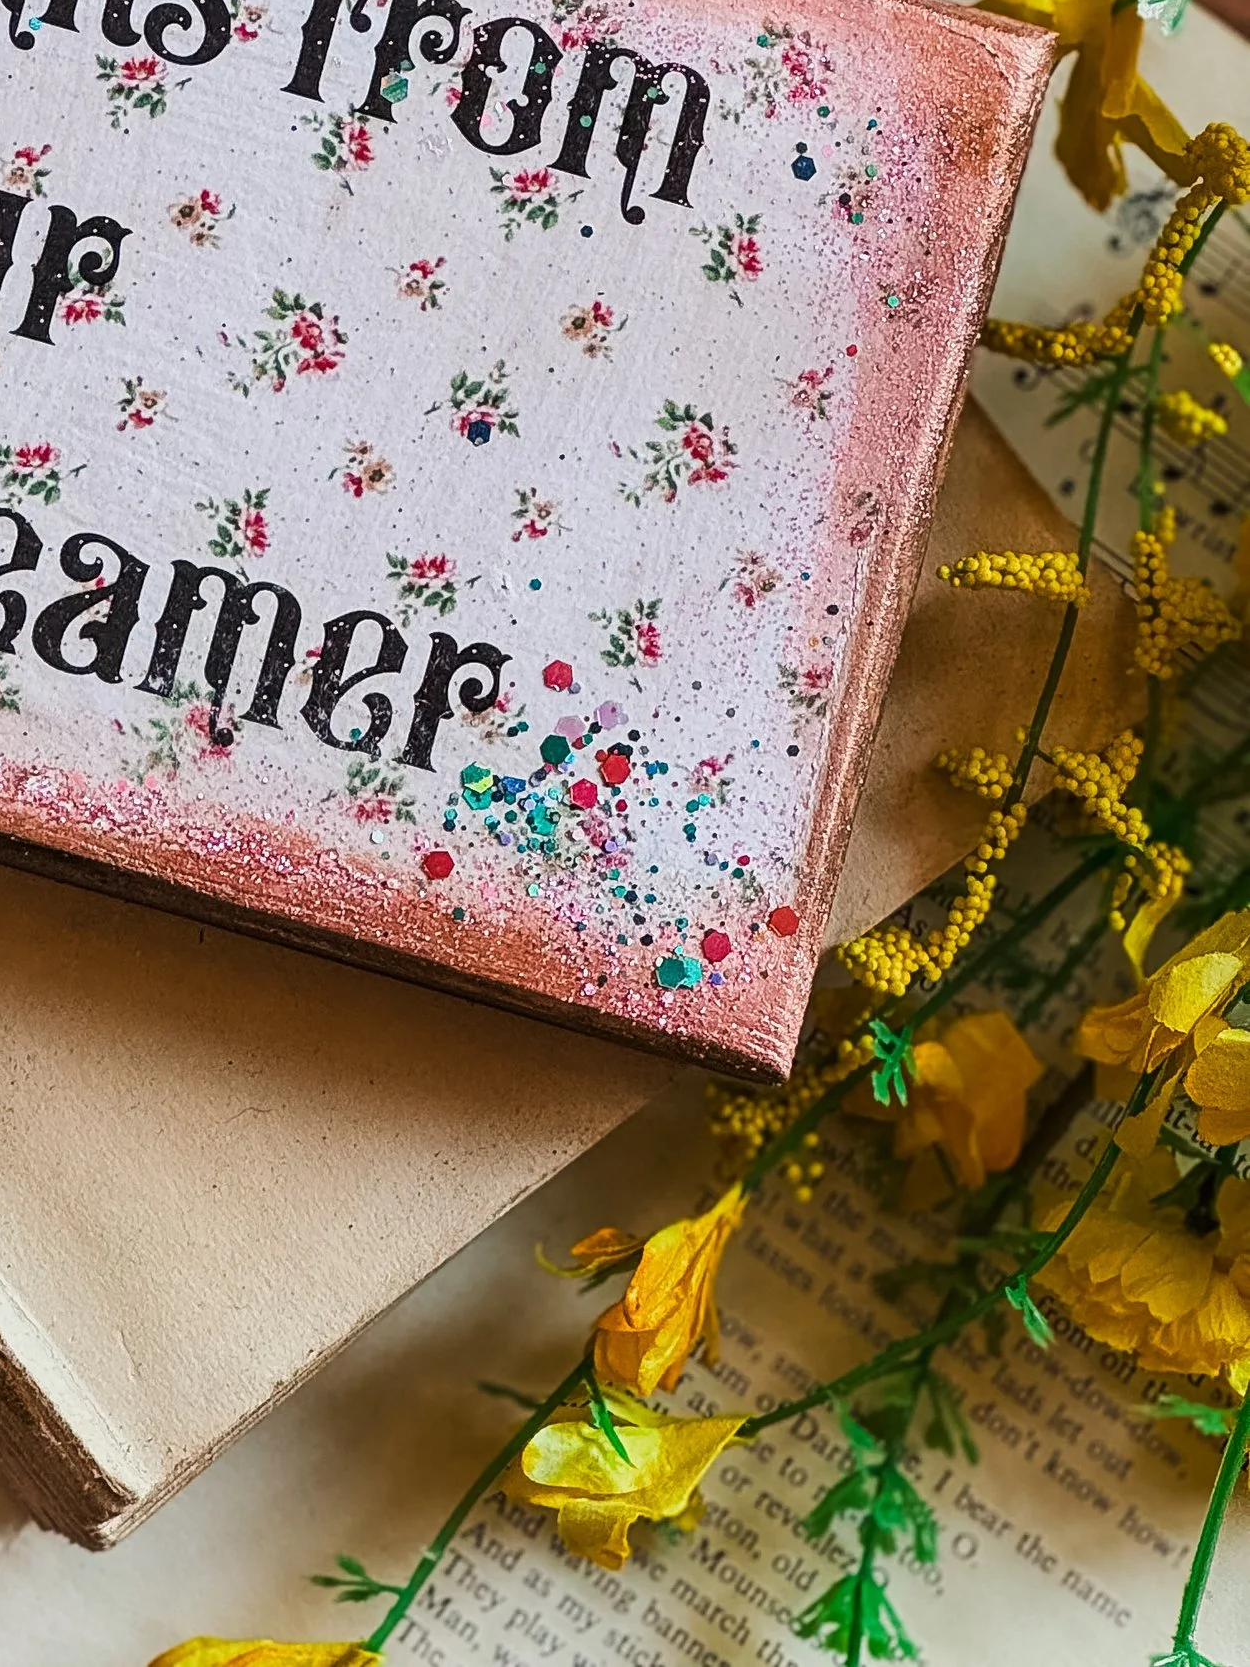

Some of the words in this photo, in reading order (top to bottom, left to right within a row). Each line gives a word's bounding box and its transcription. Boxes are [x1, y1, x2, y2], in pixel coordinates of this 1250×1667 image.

[990, 1357, 1042, 1414] lads
[1045, 1402, 1084, 1444] let
[1086, 1441, 1140, 1482] out
[719, 1466, 754, 1494] or
[778, 1455, 808, 1487] to
[962, 1392, 1040, 1460] don't
[1042, 1449, 1111, 1511] know
[1114, 1501, 1197, 1567] how!
[483, 1485, 548, 1537] And
[459, 1513, 523, 1570] And
[522, 1567, 551, 1598] as
[557, 1593, 601, 1634] my
[770, 1554, 819, 1593] old
[933, 1468, 953, 1494] I
[953, 1482, 1012, 1536] bear
[1015, 1531, 1058, 1573] the
[1058, 1562, 1130, 1626] name
[416, 1582, 477, 1649] Man,
[437, 1544, 506, 1610] They
[503, 1607, 564, 1658] play
[671, 1579, 750, 1646] march
